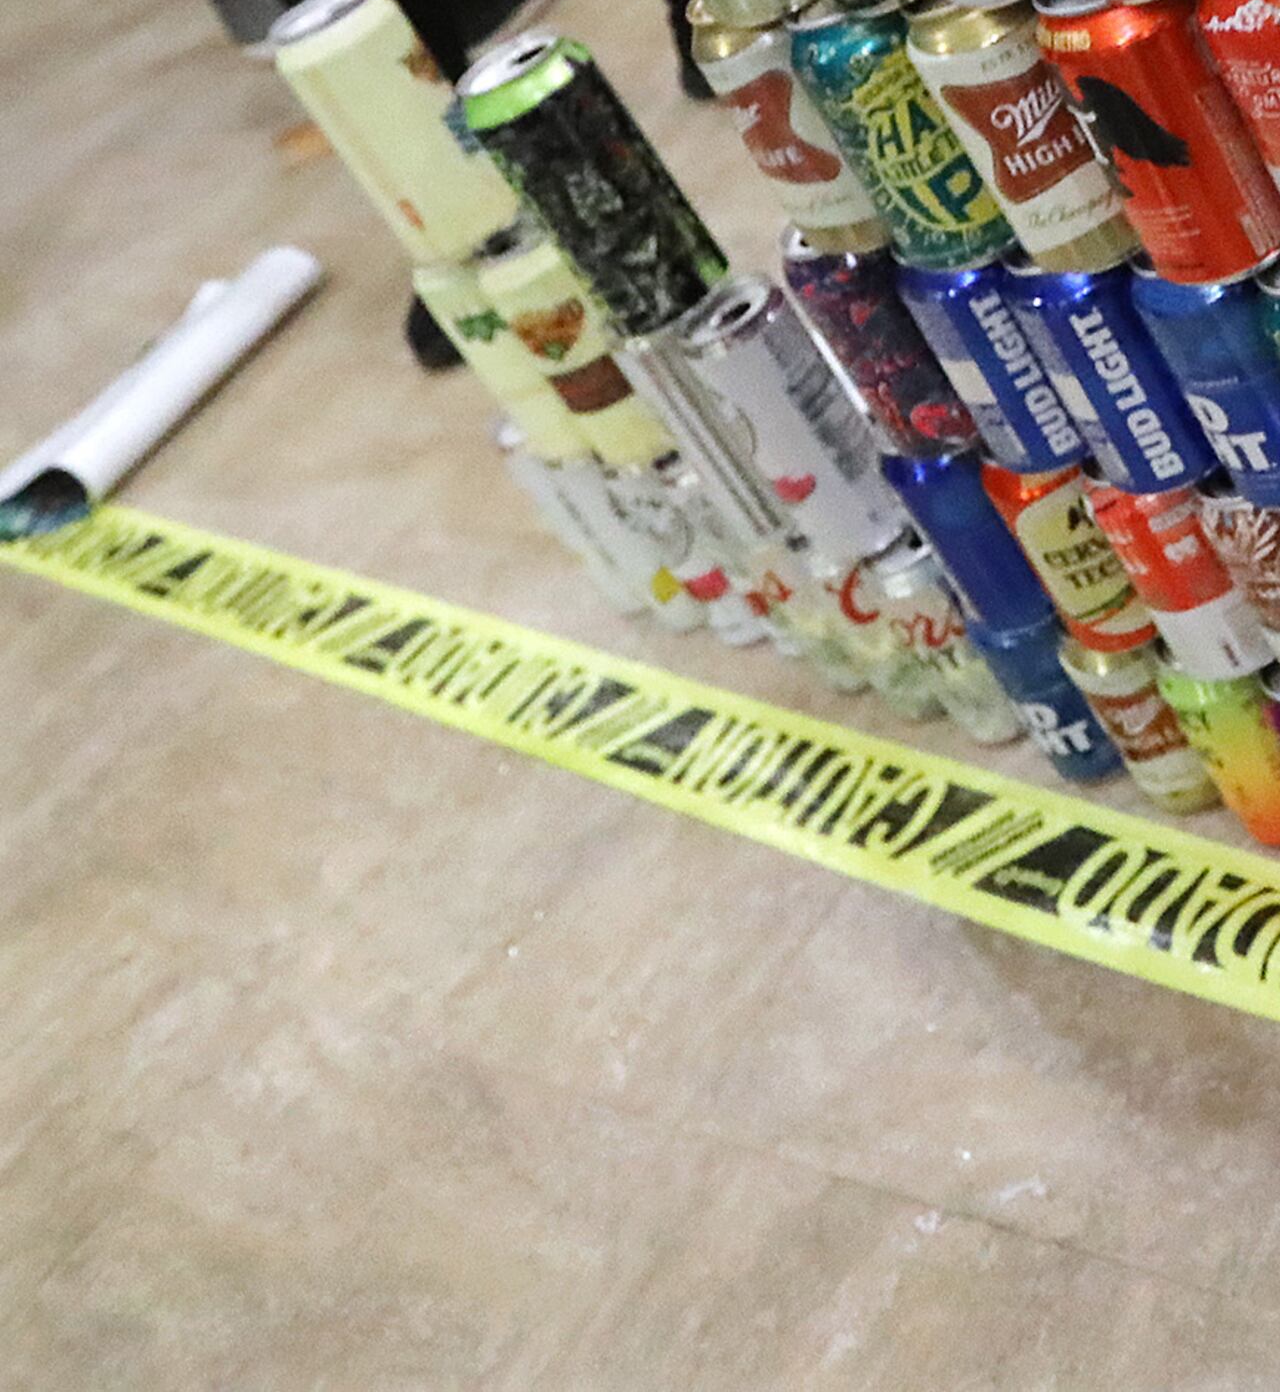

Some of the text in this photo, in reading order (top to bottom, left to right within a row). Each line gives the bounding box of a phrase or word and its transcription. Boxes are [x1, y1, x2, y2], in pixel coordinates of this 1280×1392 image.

[1003, 134, 1074, 177] HIGH
[968, 288, 1081, 457] BUD LIGHT
[1068, 305, 1186, 480] BUD LIGHT
